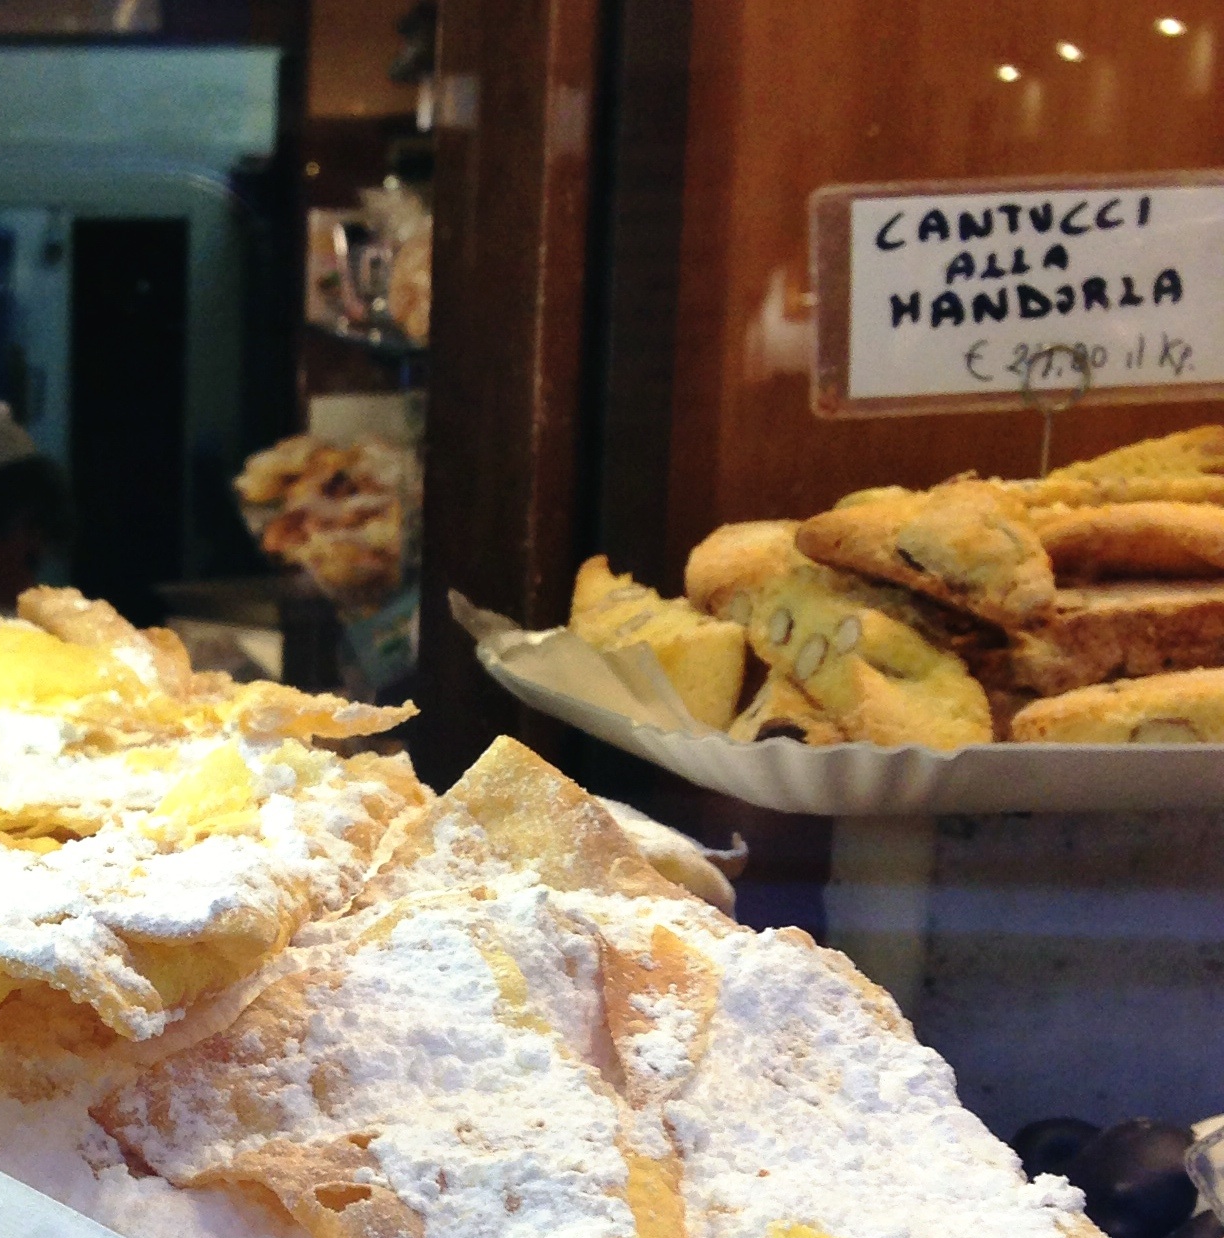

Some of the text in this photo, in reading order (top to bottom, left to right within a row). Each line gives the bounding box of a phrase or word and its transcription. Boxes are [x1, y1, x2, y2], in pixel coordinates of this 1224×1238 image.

[875, 196, 1151, 251] CANTUCCI
[945, 243, 1070, 284] ALLA
[889, 267, 1184, 328] MANDORLA
[963, 337, 994, 383] €
